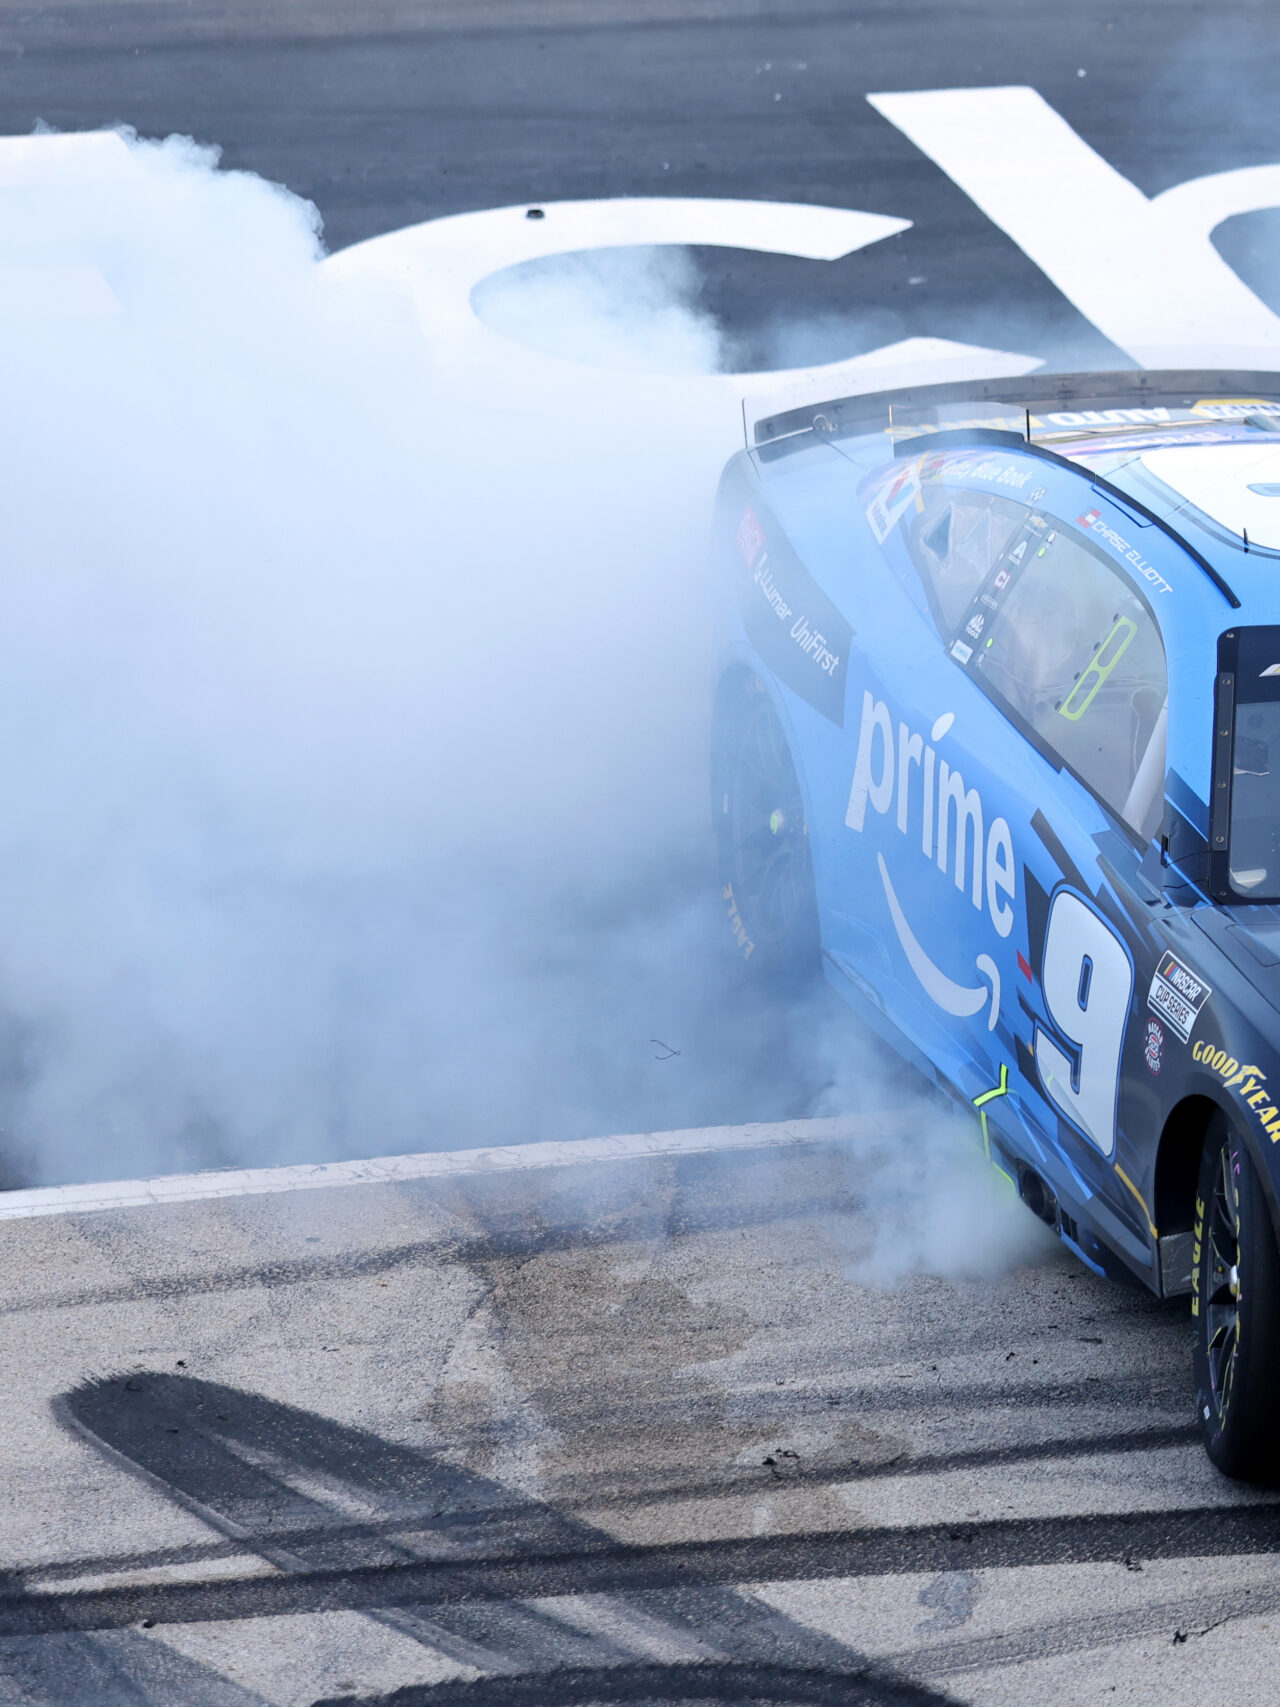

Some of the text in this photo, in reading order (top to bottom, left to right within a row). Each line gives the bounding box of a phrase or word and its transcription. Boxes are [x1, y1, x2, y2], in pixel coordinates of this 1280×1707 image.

[1048, 406, 1170, 427] AUTO
[1091, 520, 1173, 593] CHASE ELLIOTT
[790, 615, 840, 676] UniFirst
[845, 690, 1016, 938] prime
[1155, 984, 1190, 1025] CUP SERIES
[1171, 967, 1202, 1002] NASCAR
[1034, 884, 1135, 1162] 9
